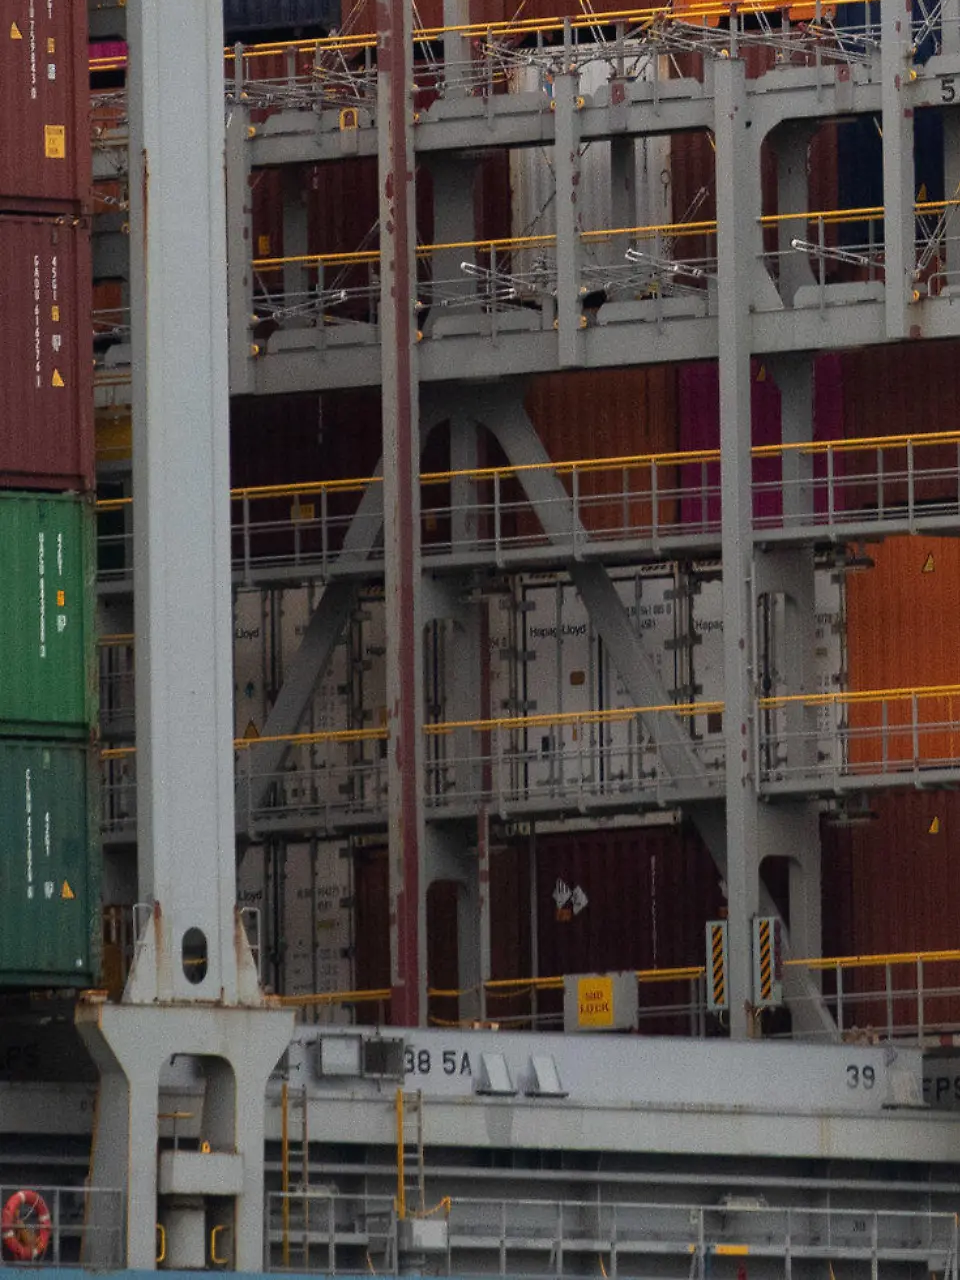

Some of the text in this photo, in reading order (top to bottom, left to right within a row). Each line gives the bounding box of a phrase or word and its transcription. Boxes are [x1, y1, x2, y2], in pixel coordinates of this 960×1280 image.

[530, 624, 586, 638] HapagLloyd
[442, 1050, 472, 1075] 5A
[846, 1065, 876, 1090] 39
